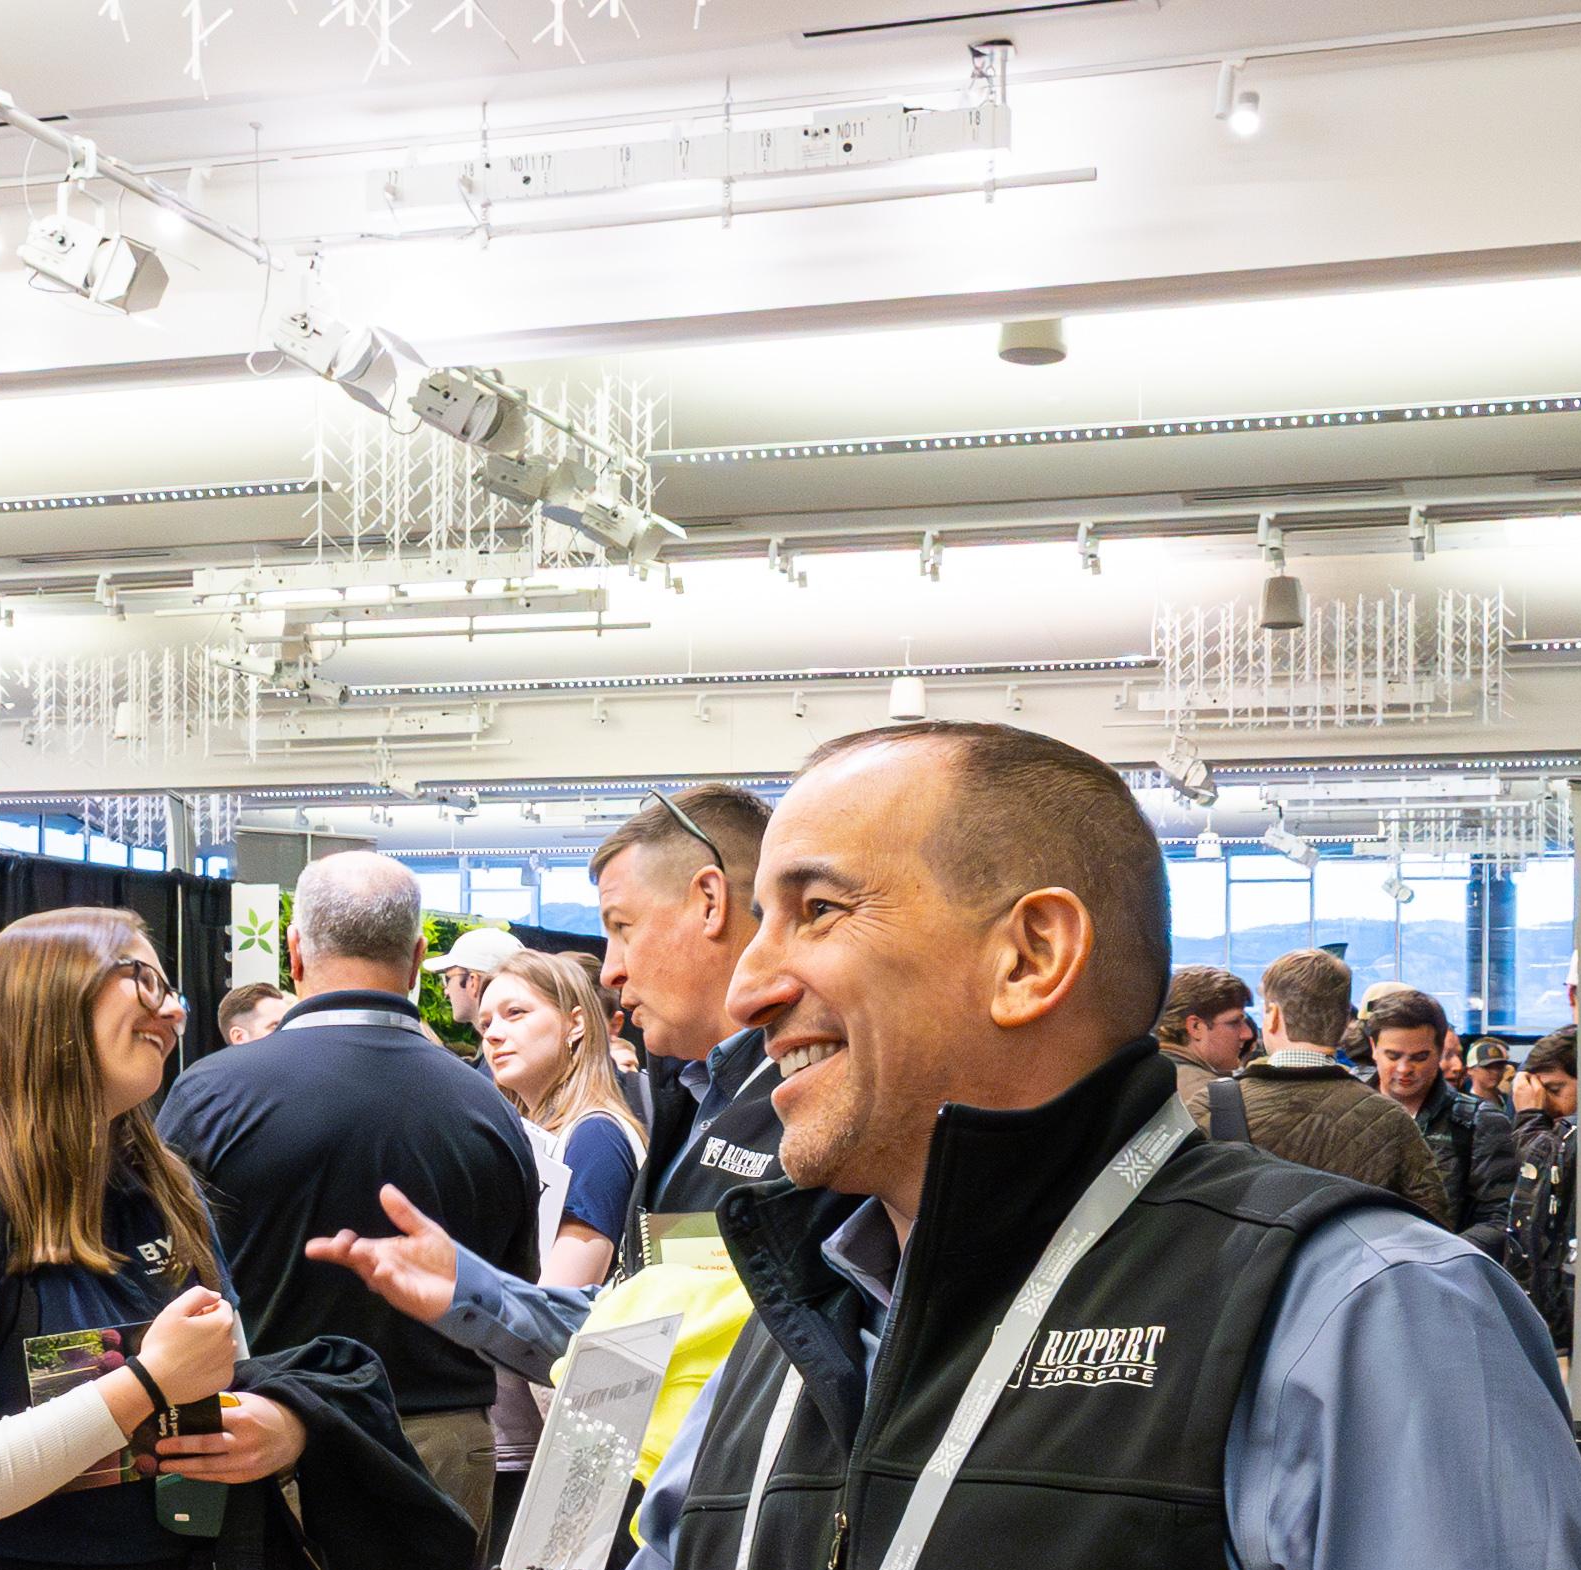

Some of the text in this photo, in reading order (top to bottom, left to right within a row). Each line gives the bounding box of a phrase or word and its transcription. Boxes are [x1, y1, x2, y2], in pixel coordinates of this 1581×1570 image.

[906, 117, 917, 132] 17
[677, 140, 689, 156] 17
[1036, 1325, 1166, 1367] RUPPERT
[1030, 1367, 1154, 1383] LANDSCAPE
